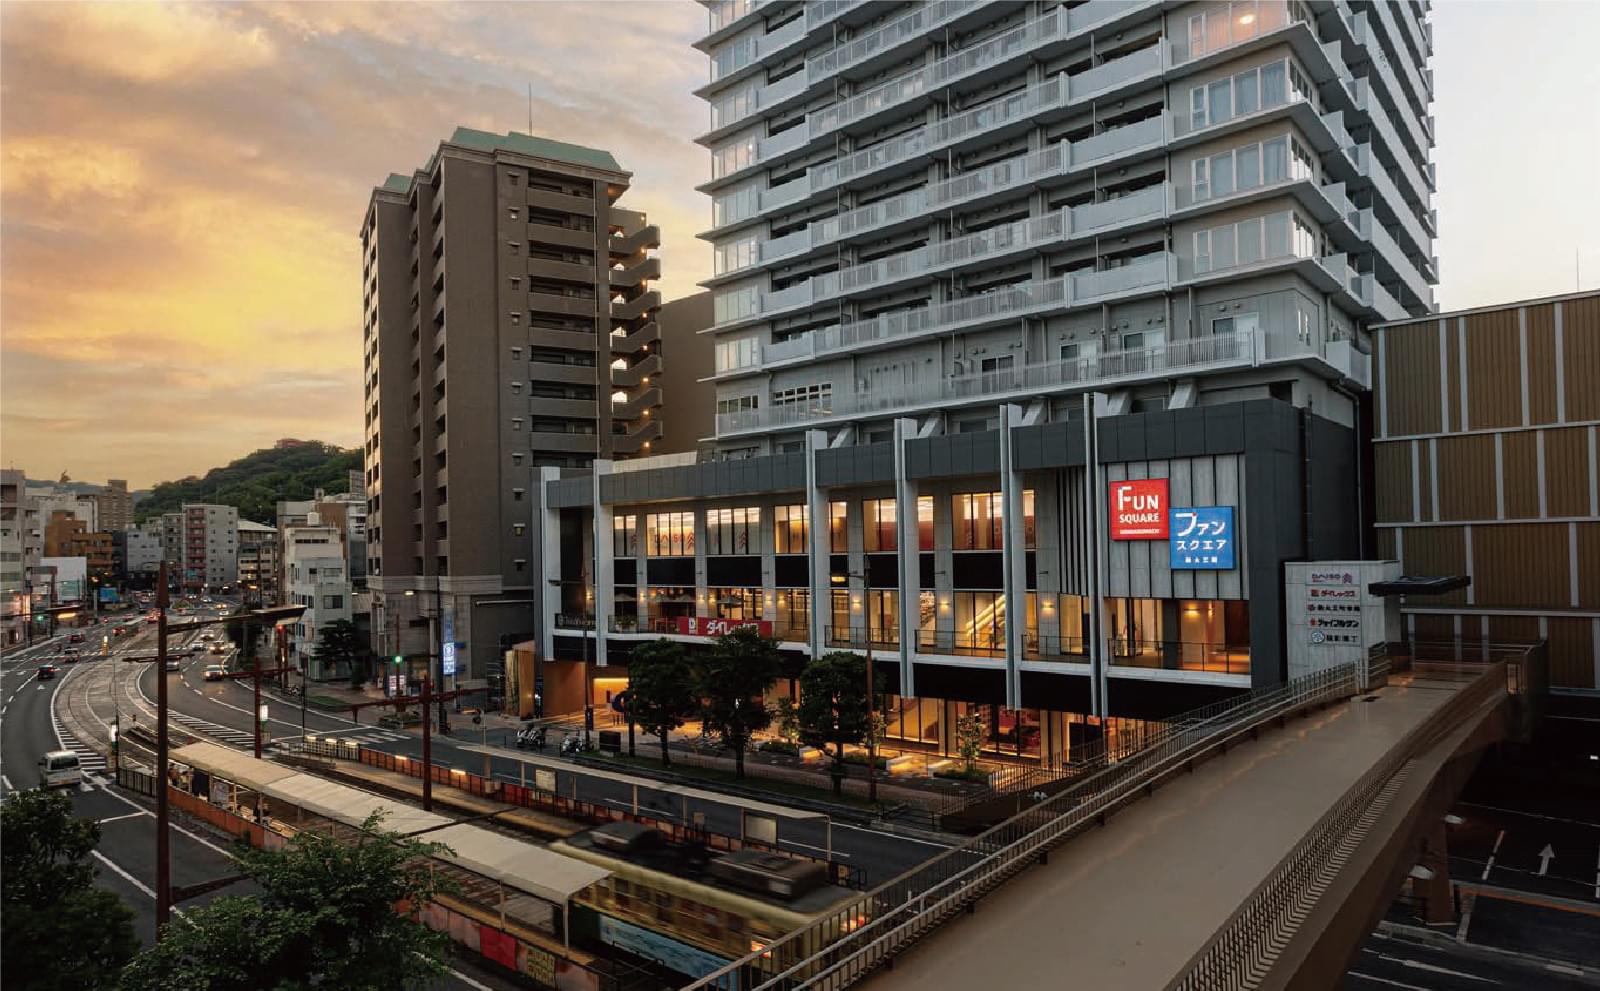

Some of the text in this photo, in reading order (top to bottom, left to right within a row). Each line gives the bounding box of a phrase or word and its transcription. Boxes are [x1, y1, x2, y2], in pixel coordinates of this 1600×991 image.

[1117, 486, 1159, 511] FUN
[1119, 512, 1160, 524] SQUARE
[1175, 512, 1226, 537] ファン
[1176, 539, 1227, 551] スクエア
